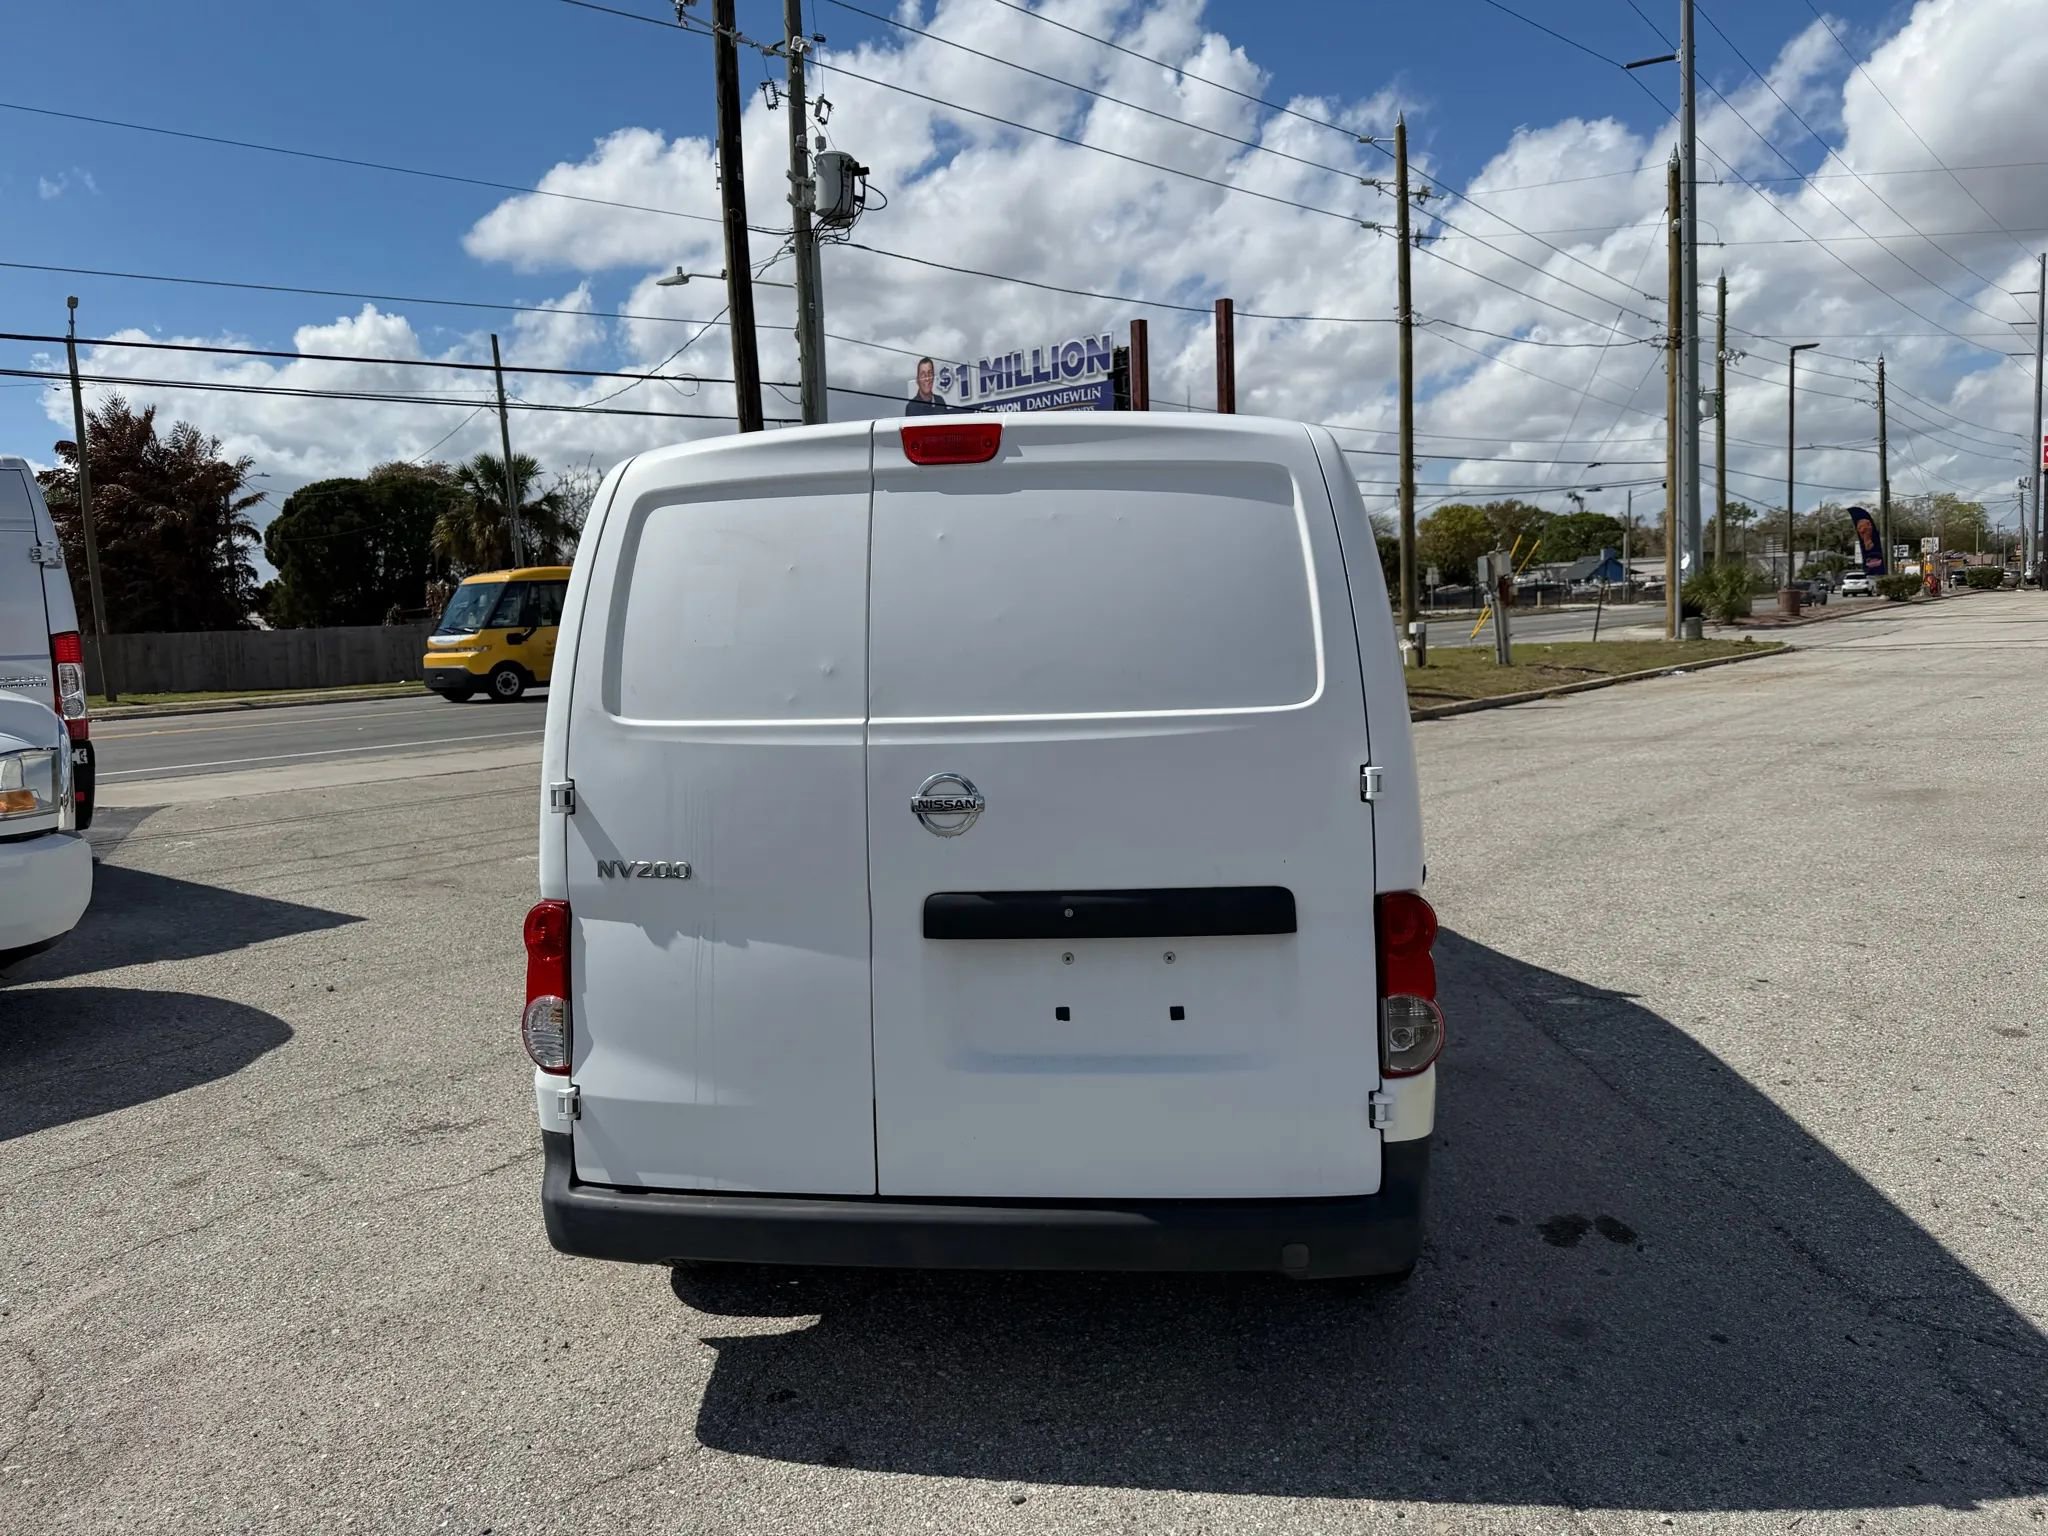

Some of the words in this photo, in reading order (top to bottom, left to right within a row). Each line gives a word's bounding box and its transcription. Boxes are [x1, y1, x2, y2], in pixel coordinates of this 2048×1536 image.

[938, 363, 970, 398] $1
[979, 333, 1111, 394] MILLION
[996, 401, 1021, 412] WON
[1026, 398, 1053, 410] DAN
[1053, 386, 1102, 405] NEWLIN
[918, 799, 976, 810] NISSAN
[597, 859, 692, 880] NV200
